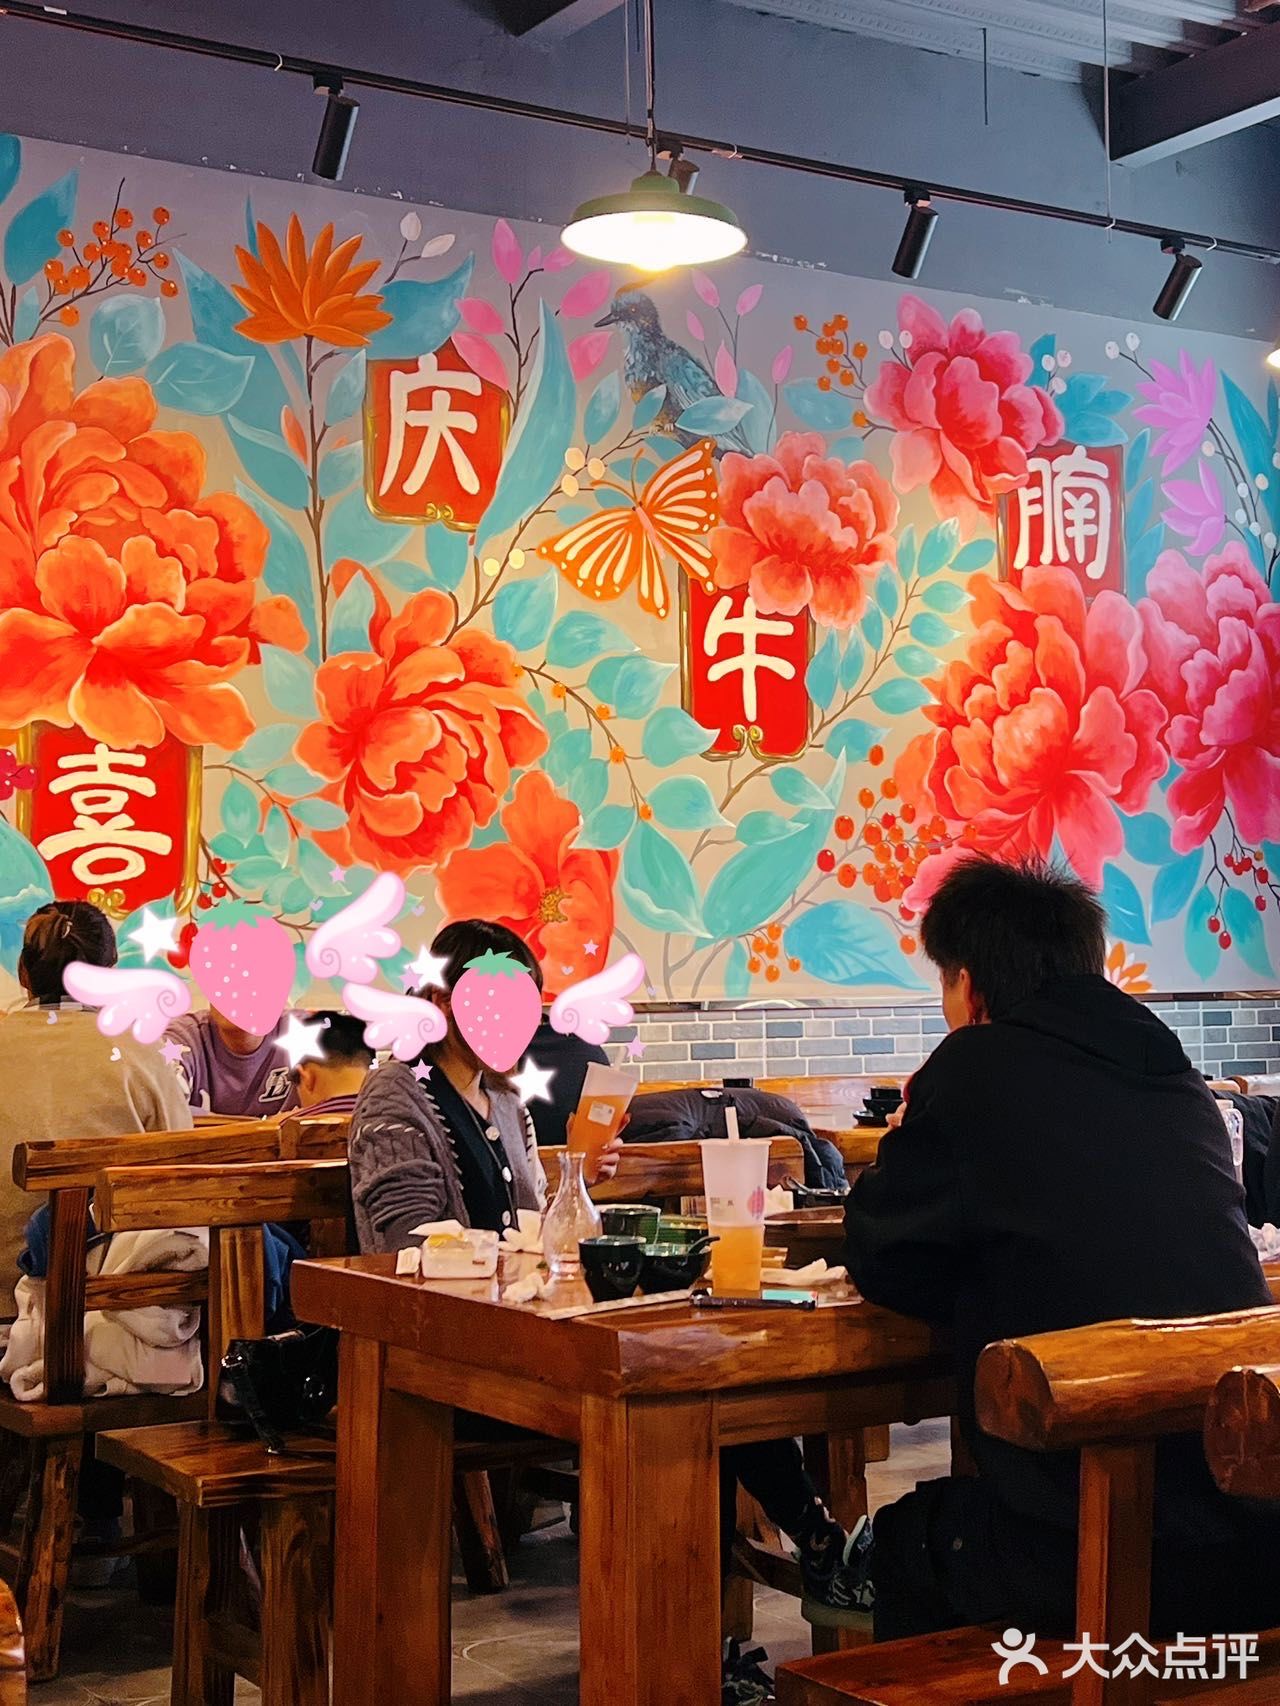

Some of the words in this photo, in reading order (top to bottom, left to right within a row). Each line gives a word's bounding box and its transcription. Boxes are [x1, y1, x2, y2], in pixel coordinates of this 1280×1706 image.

[379, 352, 483, 497] 庆
[1013, 444, 1112, 580] 腩
[702, 595, 796, 723] 牛
[36, 742, 173, 886] 喜
